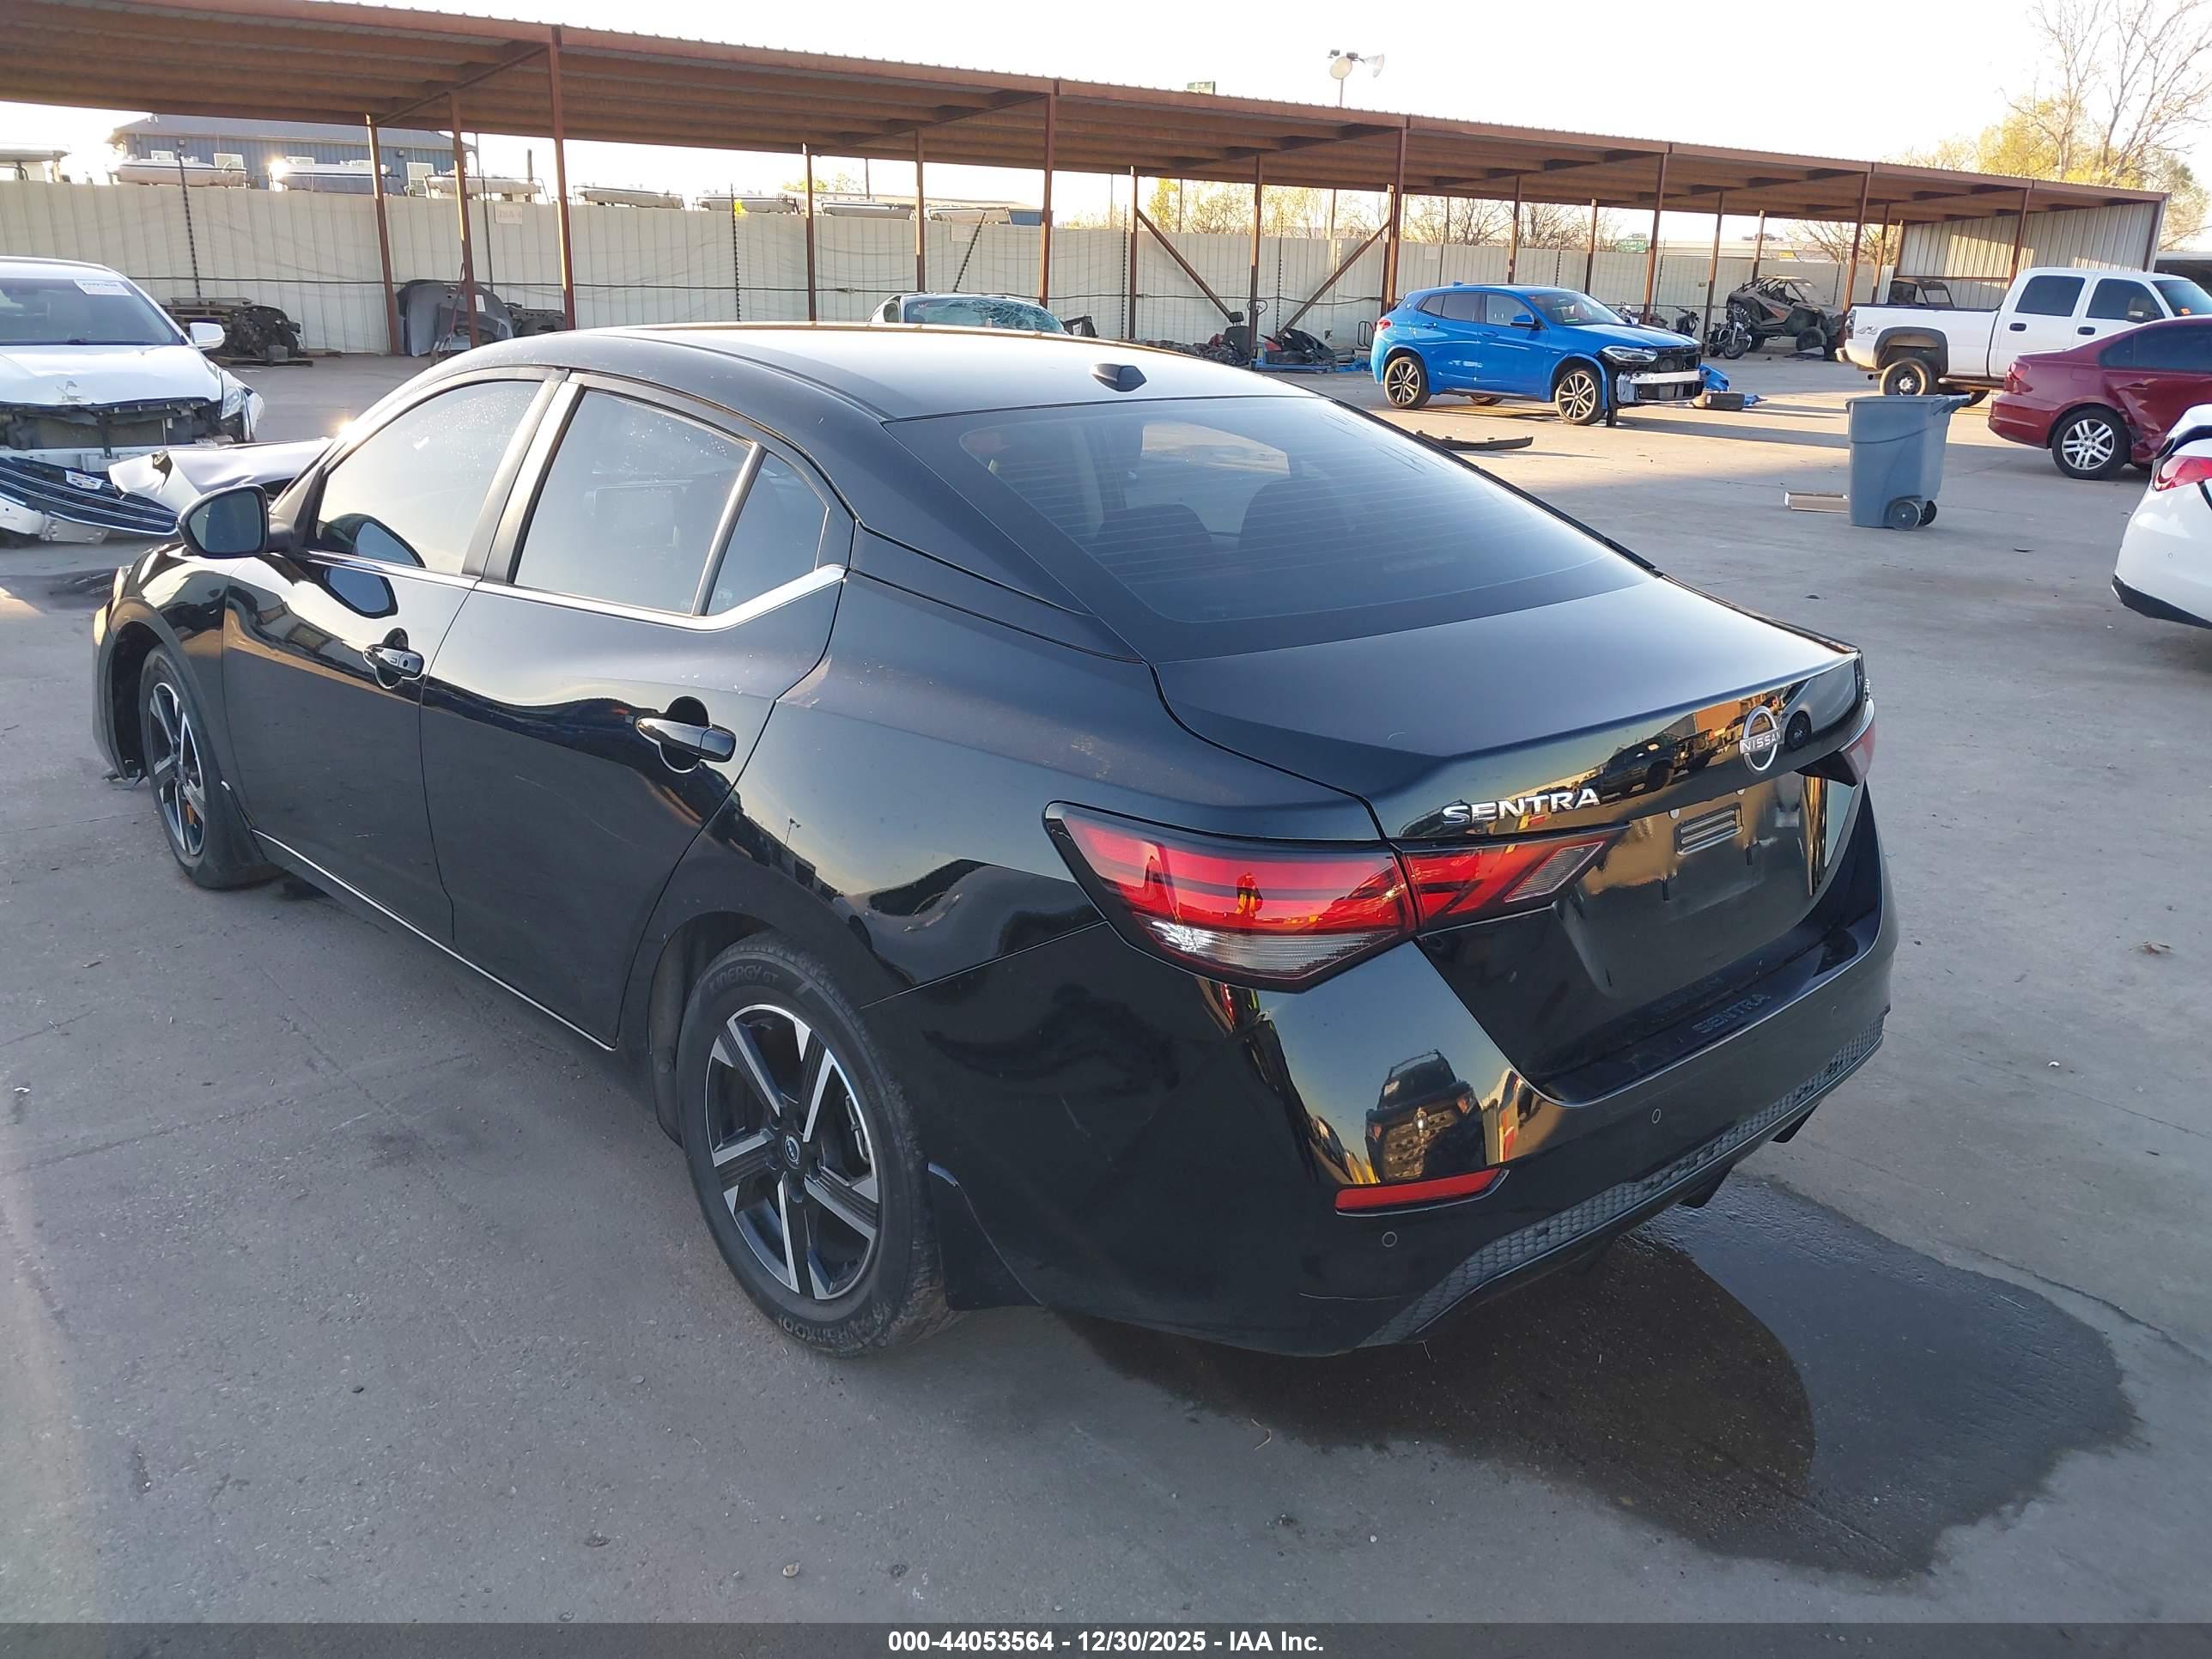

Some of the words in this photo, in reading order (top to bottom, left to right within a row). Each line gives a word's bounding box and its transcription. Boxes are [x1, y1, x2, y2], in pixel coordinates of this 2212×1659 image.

[1741, 731, 1781, 751] NISSAN
[1443, 787, 1601, 825] SENTRA
[1691, 993, 1771, 1034] SENTRA
